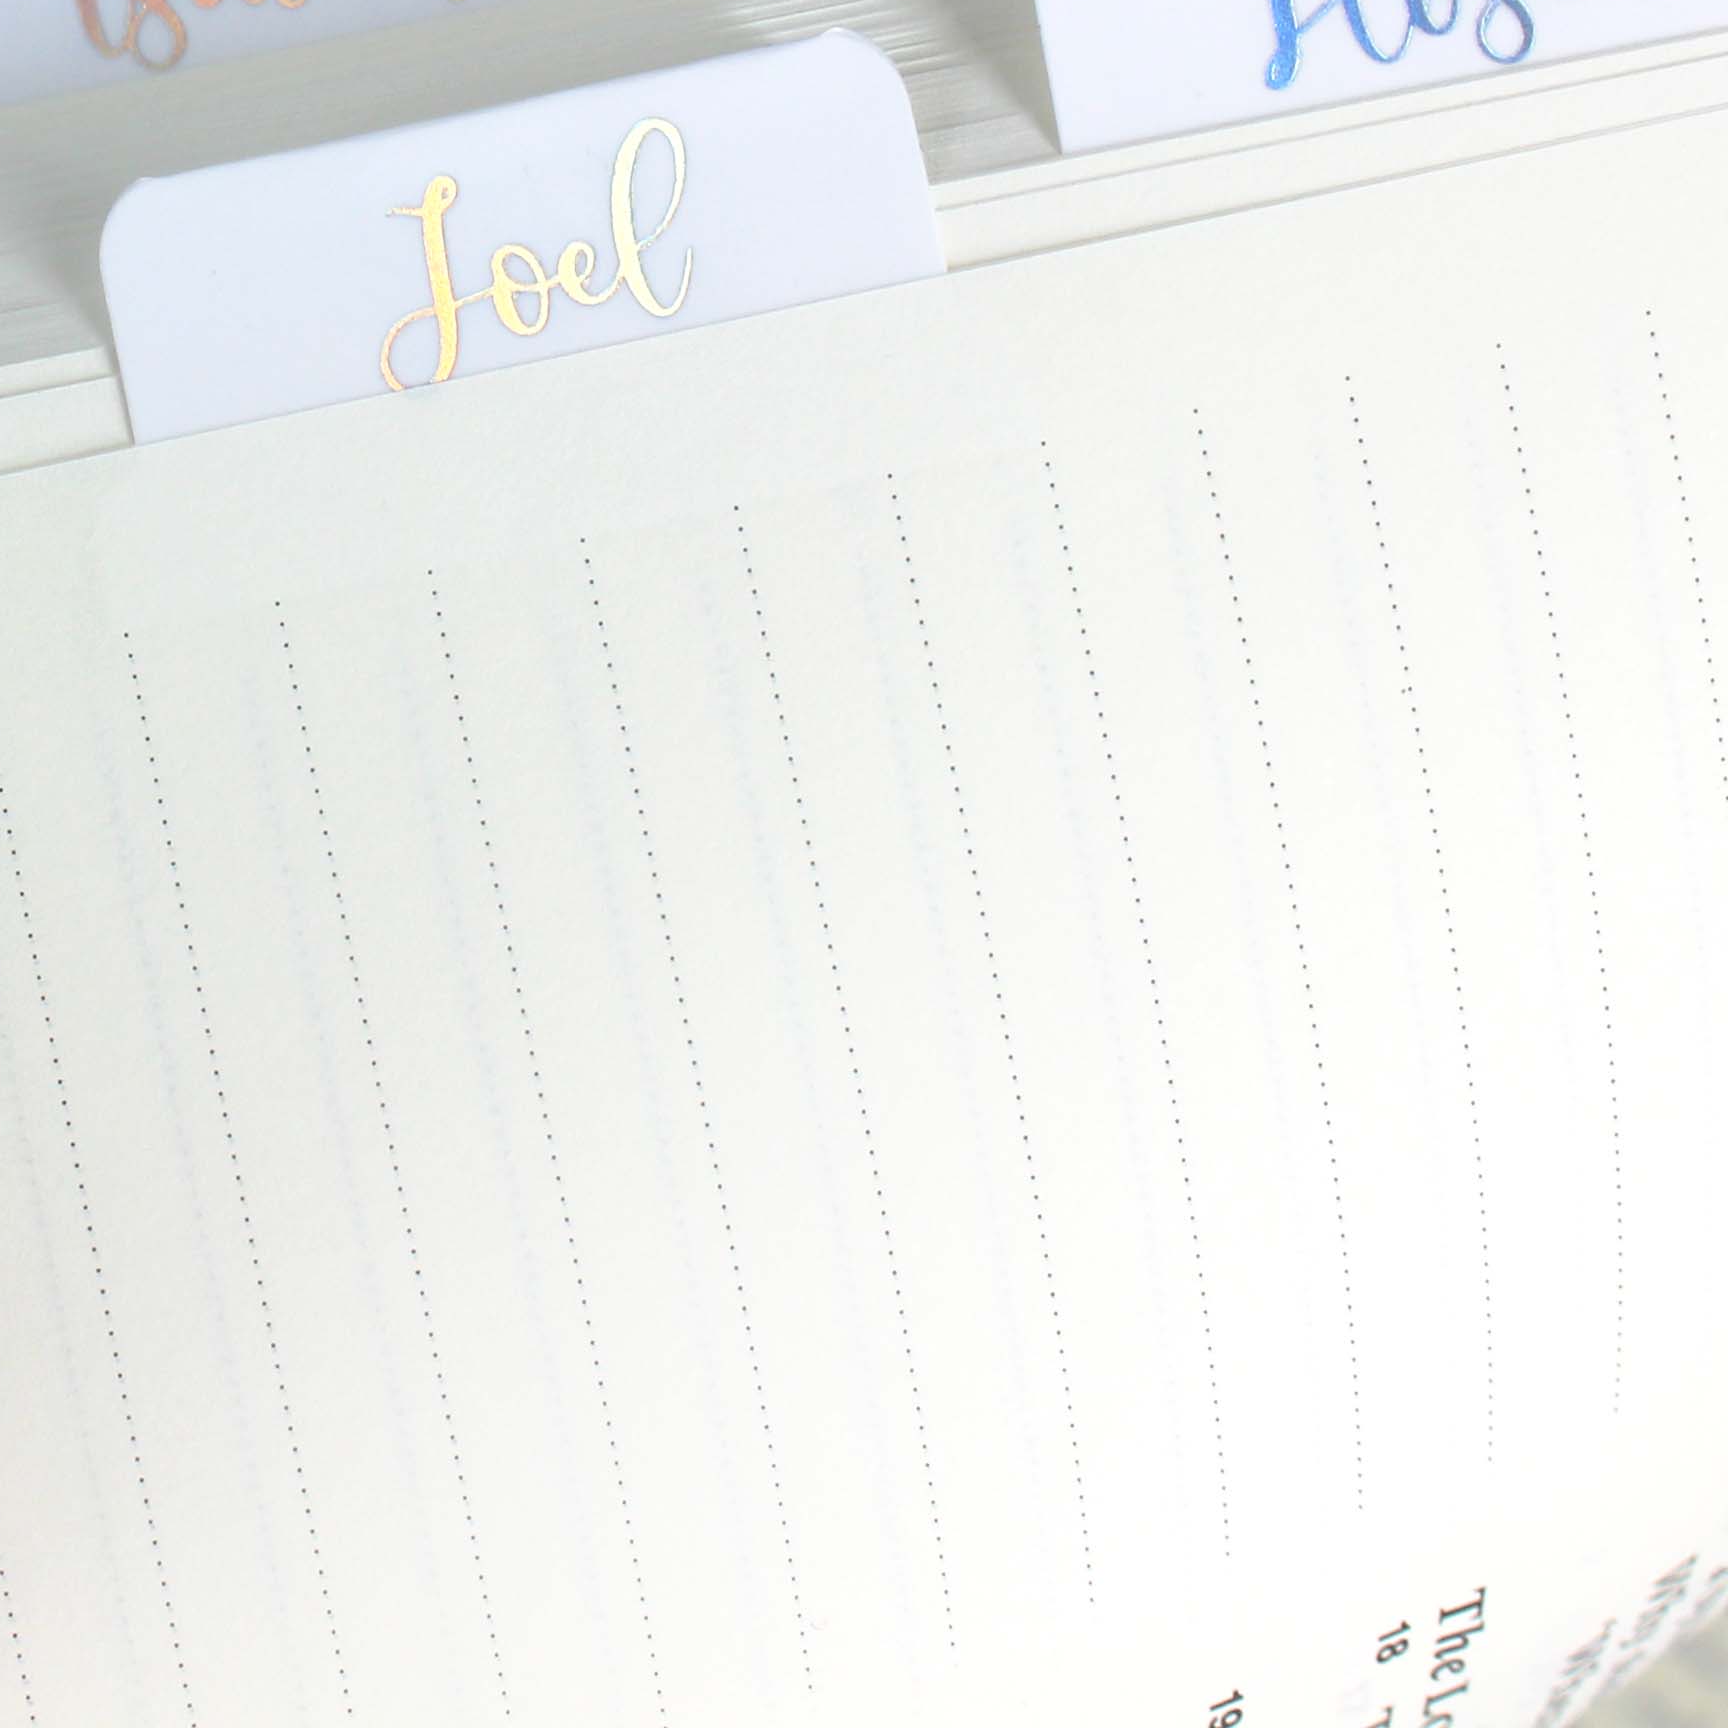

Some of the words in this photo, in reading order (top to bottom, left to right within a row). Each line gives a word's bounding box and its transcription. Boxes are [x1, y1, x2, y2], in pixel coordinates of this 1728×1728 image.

[380, 116, 693, 391] Joel
[1375, 1620, 1411, 1664] 18
[1430, 1586, 1486, 1681] The
